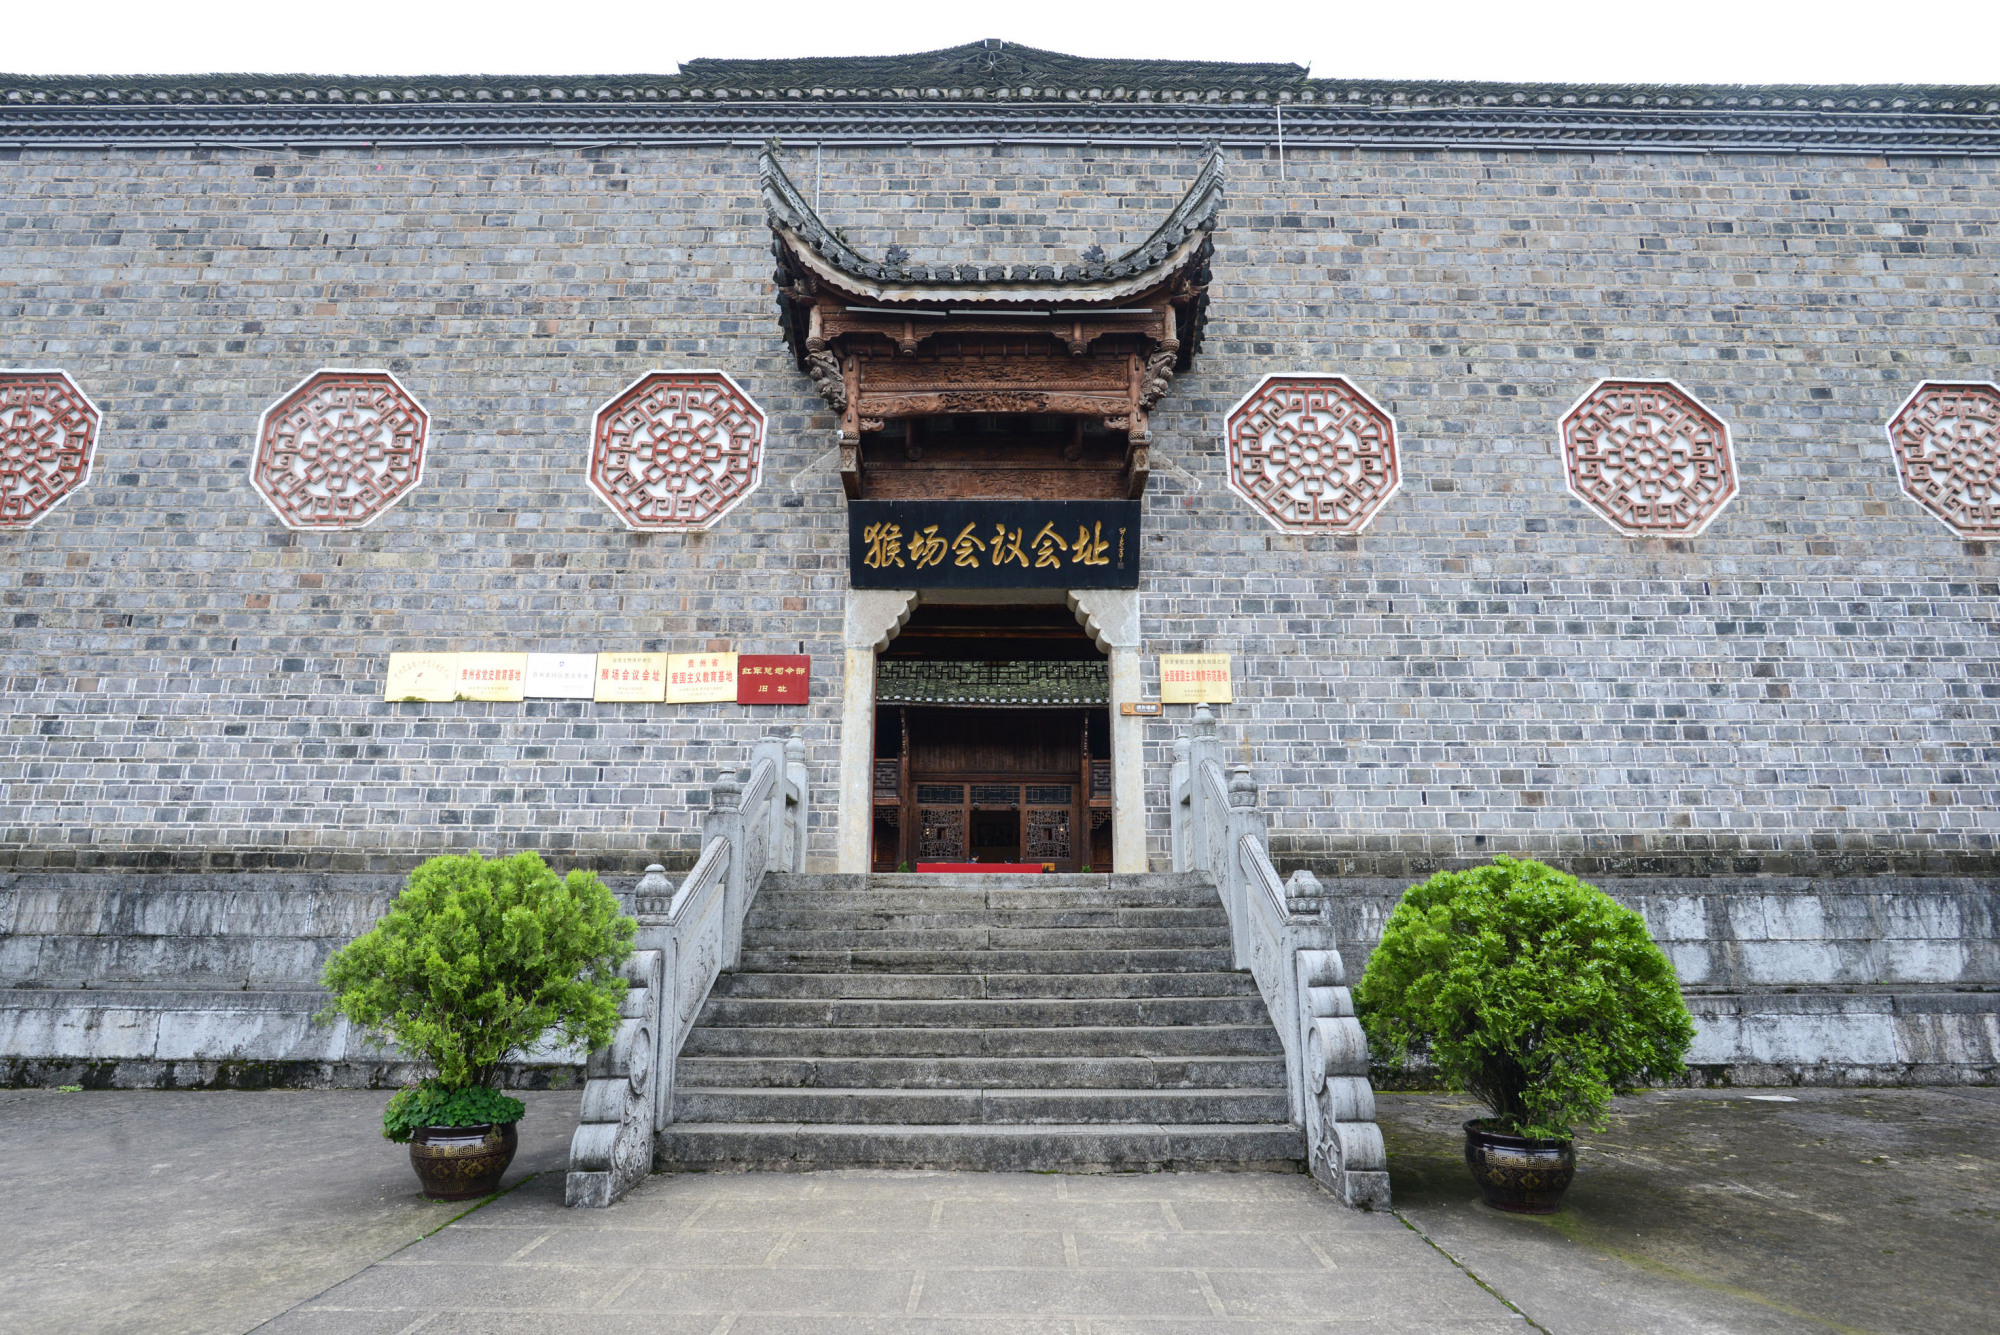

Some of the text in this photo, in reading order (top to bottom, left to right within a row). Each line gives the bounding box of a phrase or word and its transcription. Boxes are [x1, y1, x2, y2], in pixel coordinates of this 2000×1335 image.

[864, 520, 1110, 569] 猴场会议会址
[687, 657, 719, 668] 贵州省
[462, 668, 521, 682] 贵州省党史教育基地
[601, 668, 660, 682] 猴场会议会址
[671, 670, 733, 684] 爱国主义教育基地
[742, 666, 806, 676] 红军总司令部
[1164, 669, 1228, 682] 全国爱国主义教育示范基地
[758, 684, 787, 692] 旧址
